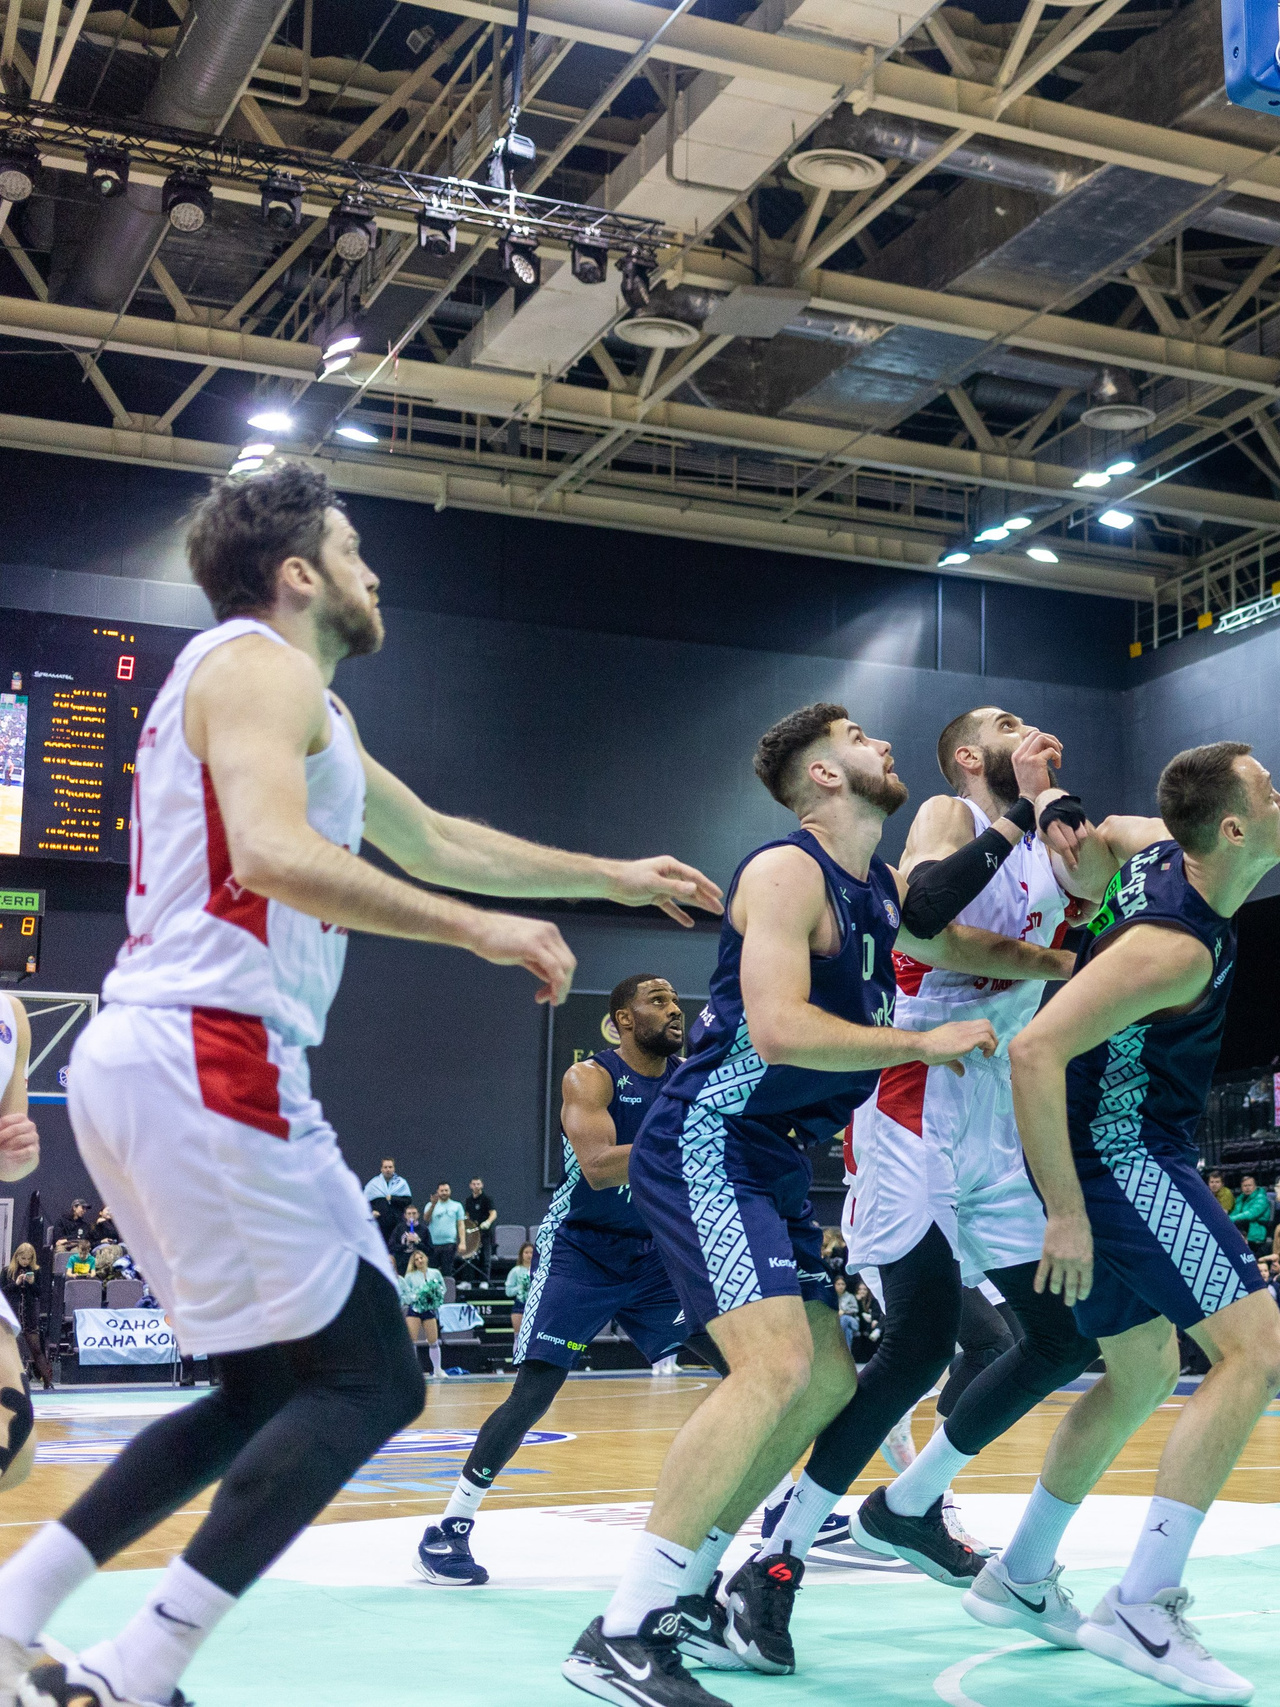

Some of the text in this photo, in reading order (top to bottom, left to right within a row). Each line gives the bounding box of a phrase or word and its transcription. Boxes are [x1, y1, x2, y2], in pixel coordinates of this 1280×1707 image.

[117, 655, 135, 680] 8
[130, 706, 139, 719] 7
[122, 762, 136, 775] 14
[20, 916, 36, 936] 8
[862, 933, 875, 981] 0
[106, 1319, 160, 1332] ОДНО
[83, 1334, 137, 1348] ОДНА
[536, 1331, 566, 1346] Kempa
